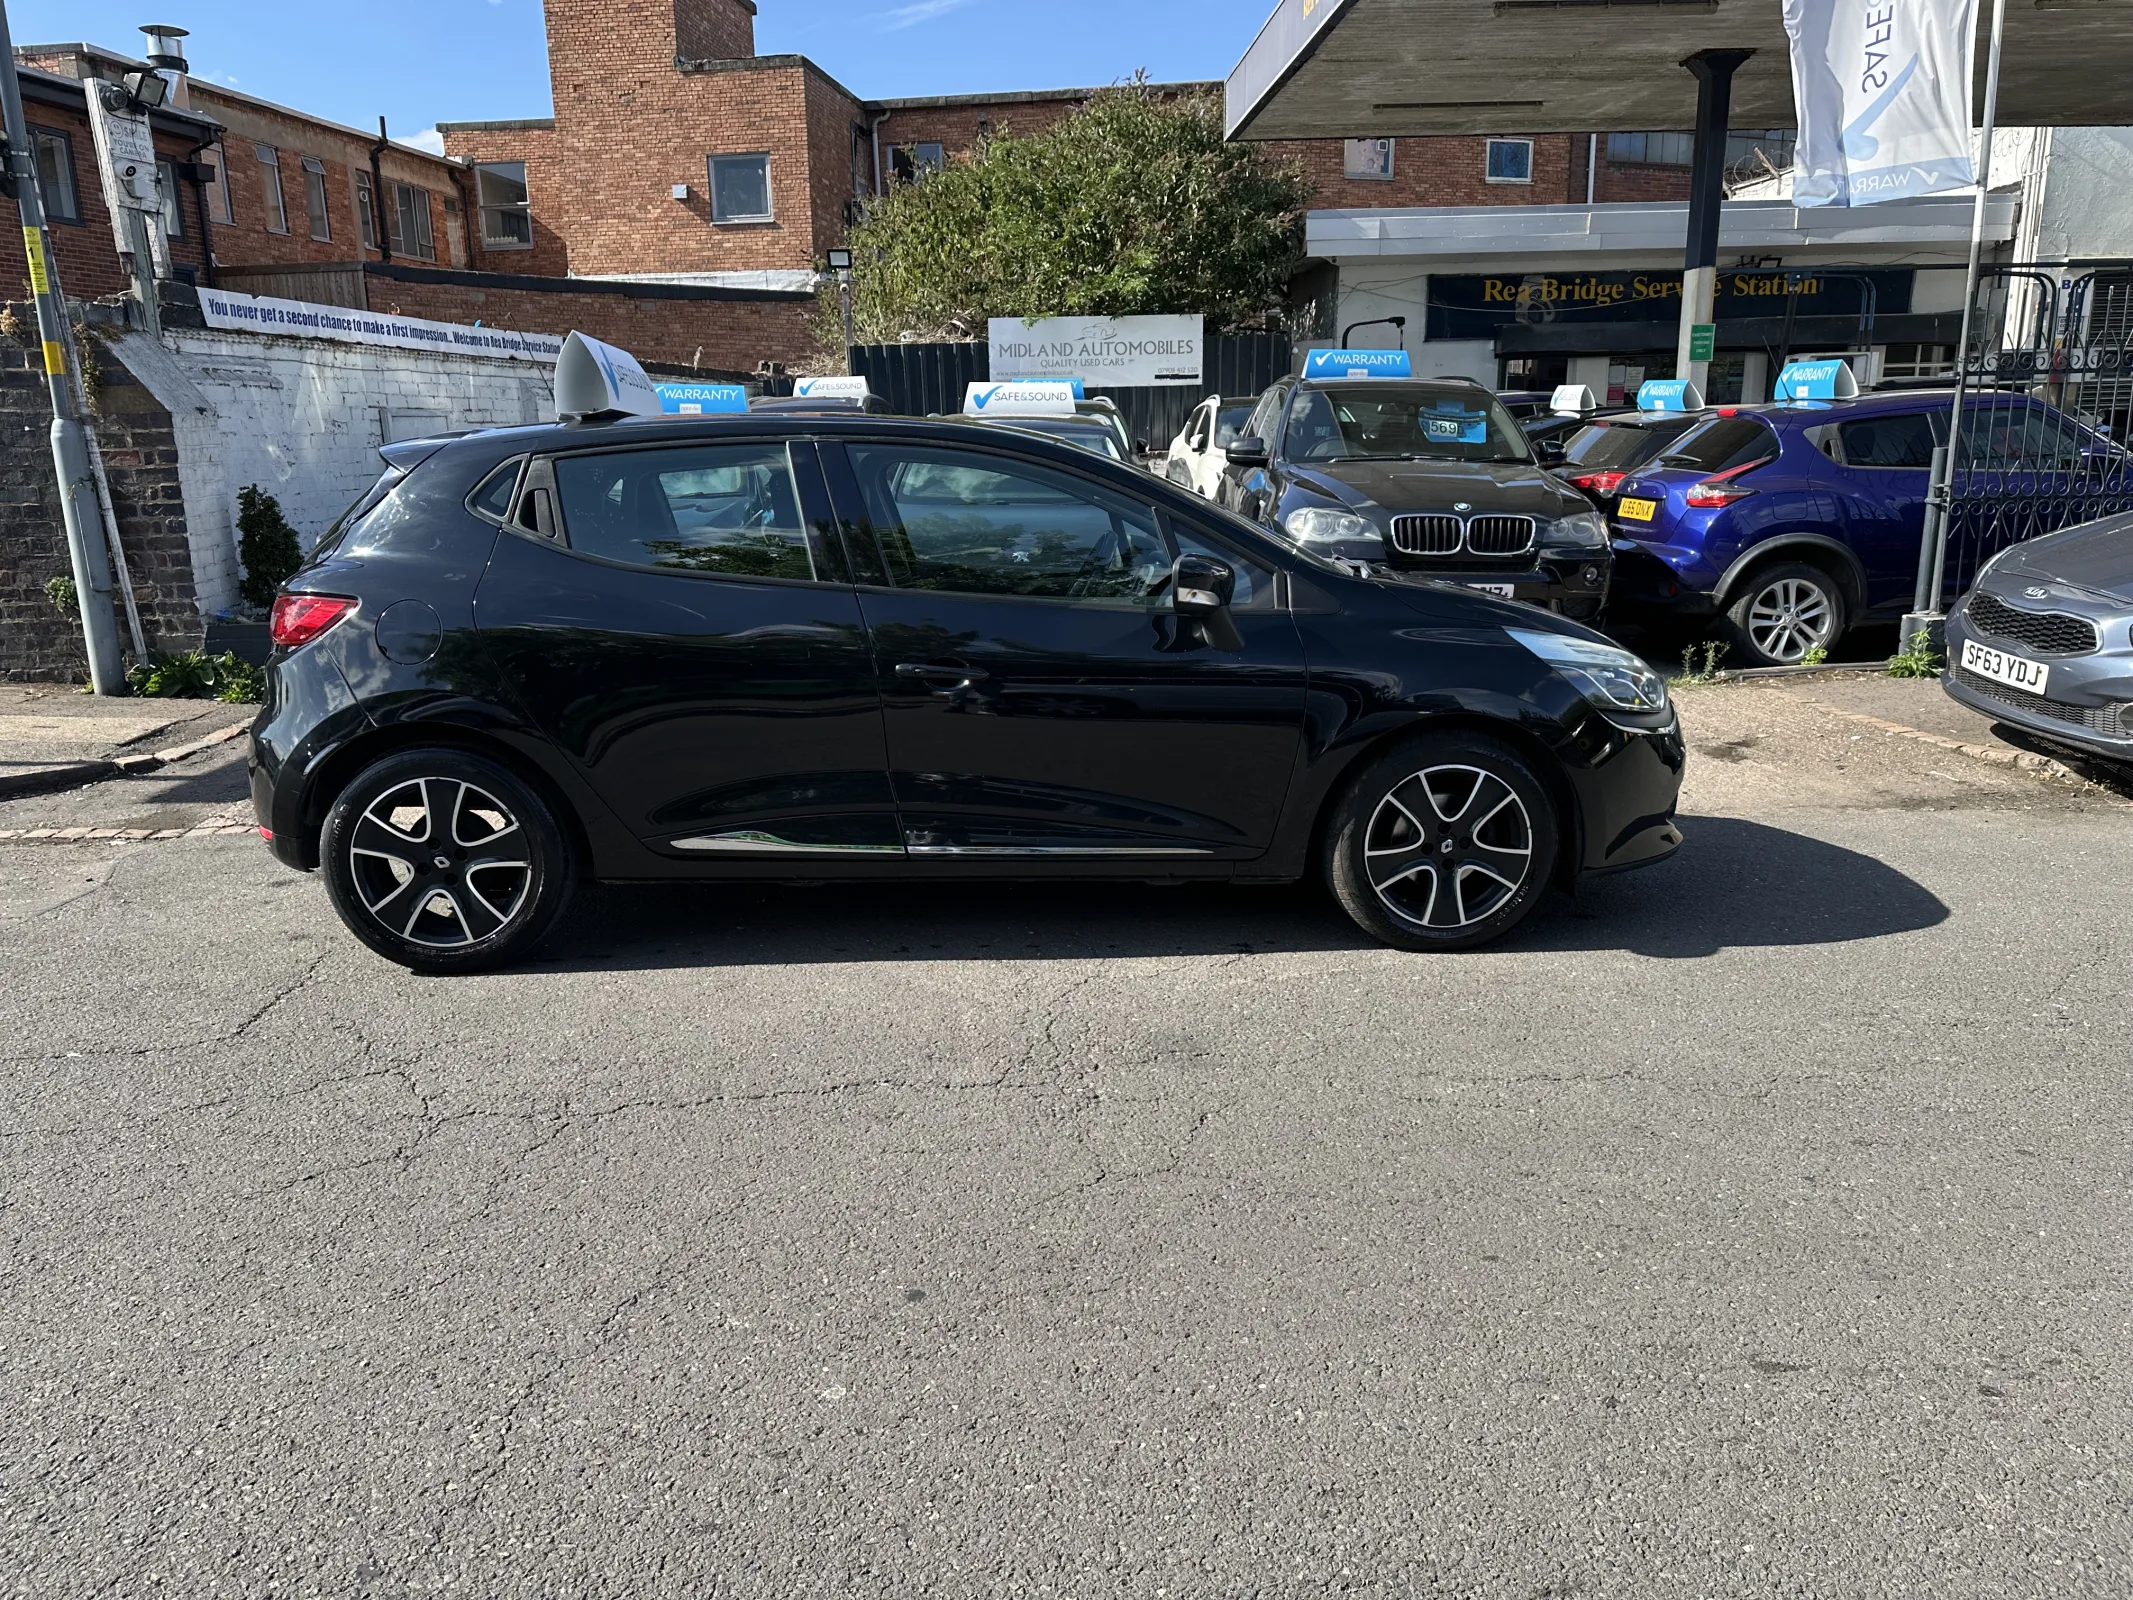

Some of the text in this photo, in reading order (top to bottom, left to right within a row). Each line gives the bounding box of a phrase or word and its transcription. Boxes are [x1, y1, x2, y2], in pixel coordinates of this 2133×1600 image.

[1483, 279, 1530, 302] Rea
[1541, 276, 1624, 305] Bridge
[1632, 275, 1722, 299] Serve
[208, 298, 229, 316] You
[230, 303, 258, 320] never
[260, 308, 276, 323] get
[278, 311, 285, 323] a
[286, 311, 319, 328] second
[320, 314, 352, 331] chance
[352, 319, 362, 332] to
[363, 320, 385, 336] make
[392, 323, 409, 338] first
[452, 331, 483, 346] Welcome
[483, 335, 490, 347] to
[502, 337, 521, 351] Bridge
[522, 340, 542, 353] Service
[542, 341, 561, 354] Station
[999, 340, 1193, 358] MIDLAND AUTOMOBILES
[1041, 357, 1124, 369] QUALITY USED CARS
[1333, 354, 1402, 365] WARRANTY
[1792, 366, 1834, 381] WARRANTY
[664, 388, 738, 400] WARRANTY
[995, 392, 1067, 402] SAFE&SOUND
[1649, 384, 1682, 397] WARRANTY
[2025, 587, 2046, 598] KIA
[1968, 644, 2041, 686] SF63 YDJ
